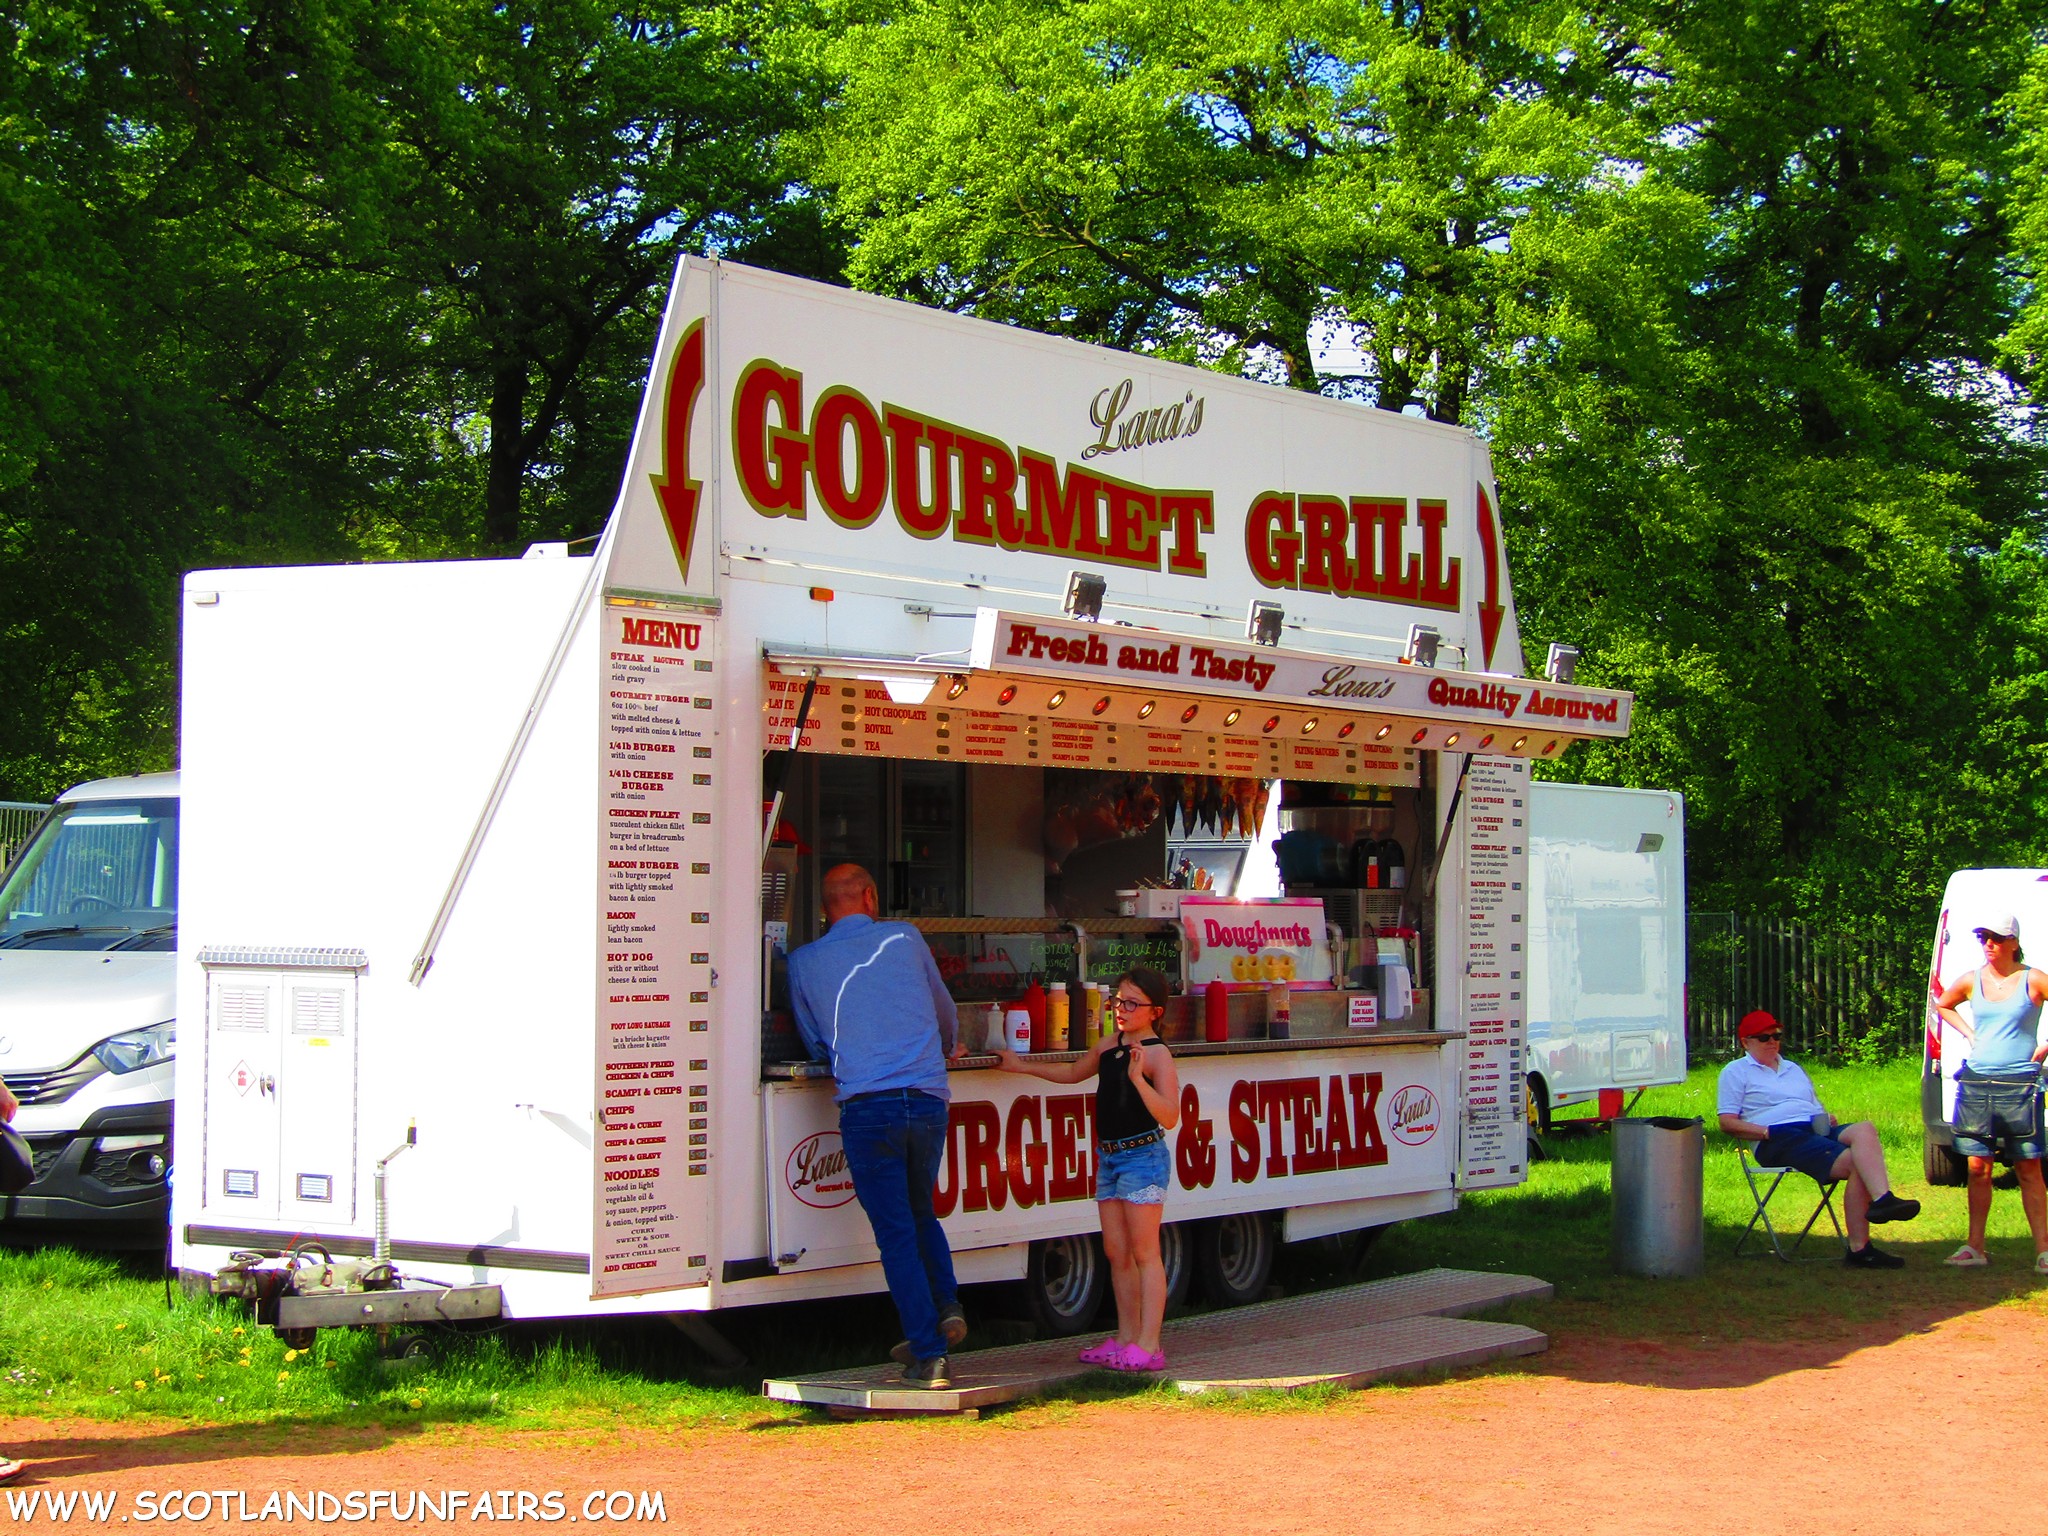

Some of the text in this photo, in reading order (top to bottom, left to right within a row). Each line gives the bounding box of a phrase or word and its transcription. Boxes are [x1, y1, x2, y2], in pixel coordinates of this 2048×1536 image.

[1081, 378, 1205, 461] Lara's
[732, 358, 1461, 613] GOURMET GRILL
[622, 617, 701, 651] MENU
[611, 652, 644, 662] STEAK
[1007, 623, 1276, 692] Fresh and Tasty
[612, 662, 626, 670] slow
[629, 664, 651, 672] cooked
[627, 676, 645, 684] gravy
[1308, 665, 1396, 699] Lara's
[769, 681, 797, 692] WHITE
[611, 691, 690, 703] GOURMET BURGER
[1427, 677, 1617, 722] Quality Assured
[769, 699, 794, 709] LATTE
[865, 707, 926, 720] HOT CHOCOLATE
[611, 725, 633, 733] topped
[679, 729, 701, 737] lettuce
[865, 724, 893, 734] BOVRIL
[633, 743, 675, 752] BURGER
[865, 741, 880, 751] TEA
[633, 771, 673, 780] CHEESE
[622, 782, 664, 791] BURGER
[609, 809, 647, 817] CHICKEN
[610, 832, 631, 840] burger
[642, 833, 684, 841] breadcrumbs
[626, 872, 647, 880] burger
[626, 883, 646, 891] lightly
[608, 925, 629, 933] lightly
[1204, 919, 1312, 954] Doughnuts
[1108, 941, 1152, 956] DOUBLE
[632, 953, 653, 961] DOG
[606, 1062, 648, 1070] SOUTHERN
[606, 1072, 641, 1080] CHICKEN
[606, 1088, 641, 1098] SCAMPI
[654, 1086, 681, 1095] CHIPS
[606, 1106, 634, 1115] CHIPS
[605, 1123, 628, 1131] CHIPS
[637, 1121, 662, 1129] CURRY
[1176, 1083, 1216, 1190] &
[1228, 1072, 1388, 1184] STEAK
[605, 1138, 627, 1147] CHIPS
[636, 1136, 666, 1144] CHEESE
[605, 1155, 627, 1163] CHIPS
[637, 1152, 661, 1161] GRAVY
[604, 1168, 659, 1181] NOODLES
[606, 1184, 628, 1192] cooked
[639, 1182, 654, 1190] light
[606, 1195, 636, 1205] vegetable
[641, 1204, 667, 1214] peppers
[635, 1215, 657, 1224] topped
[660, 1214, 674, 1222] with
[622, 1261, 657, 1270] CHICKEN
